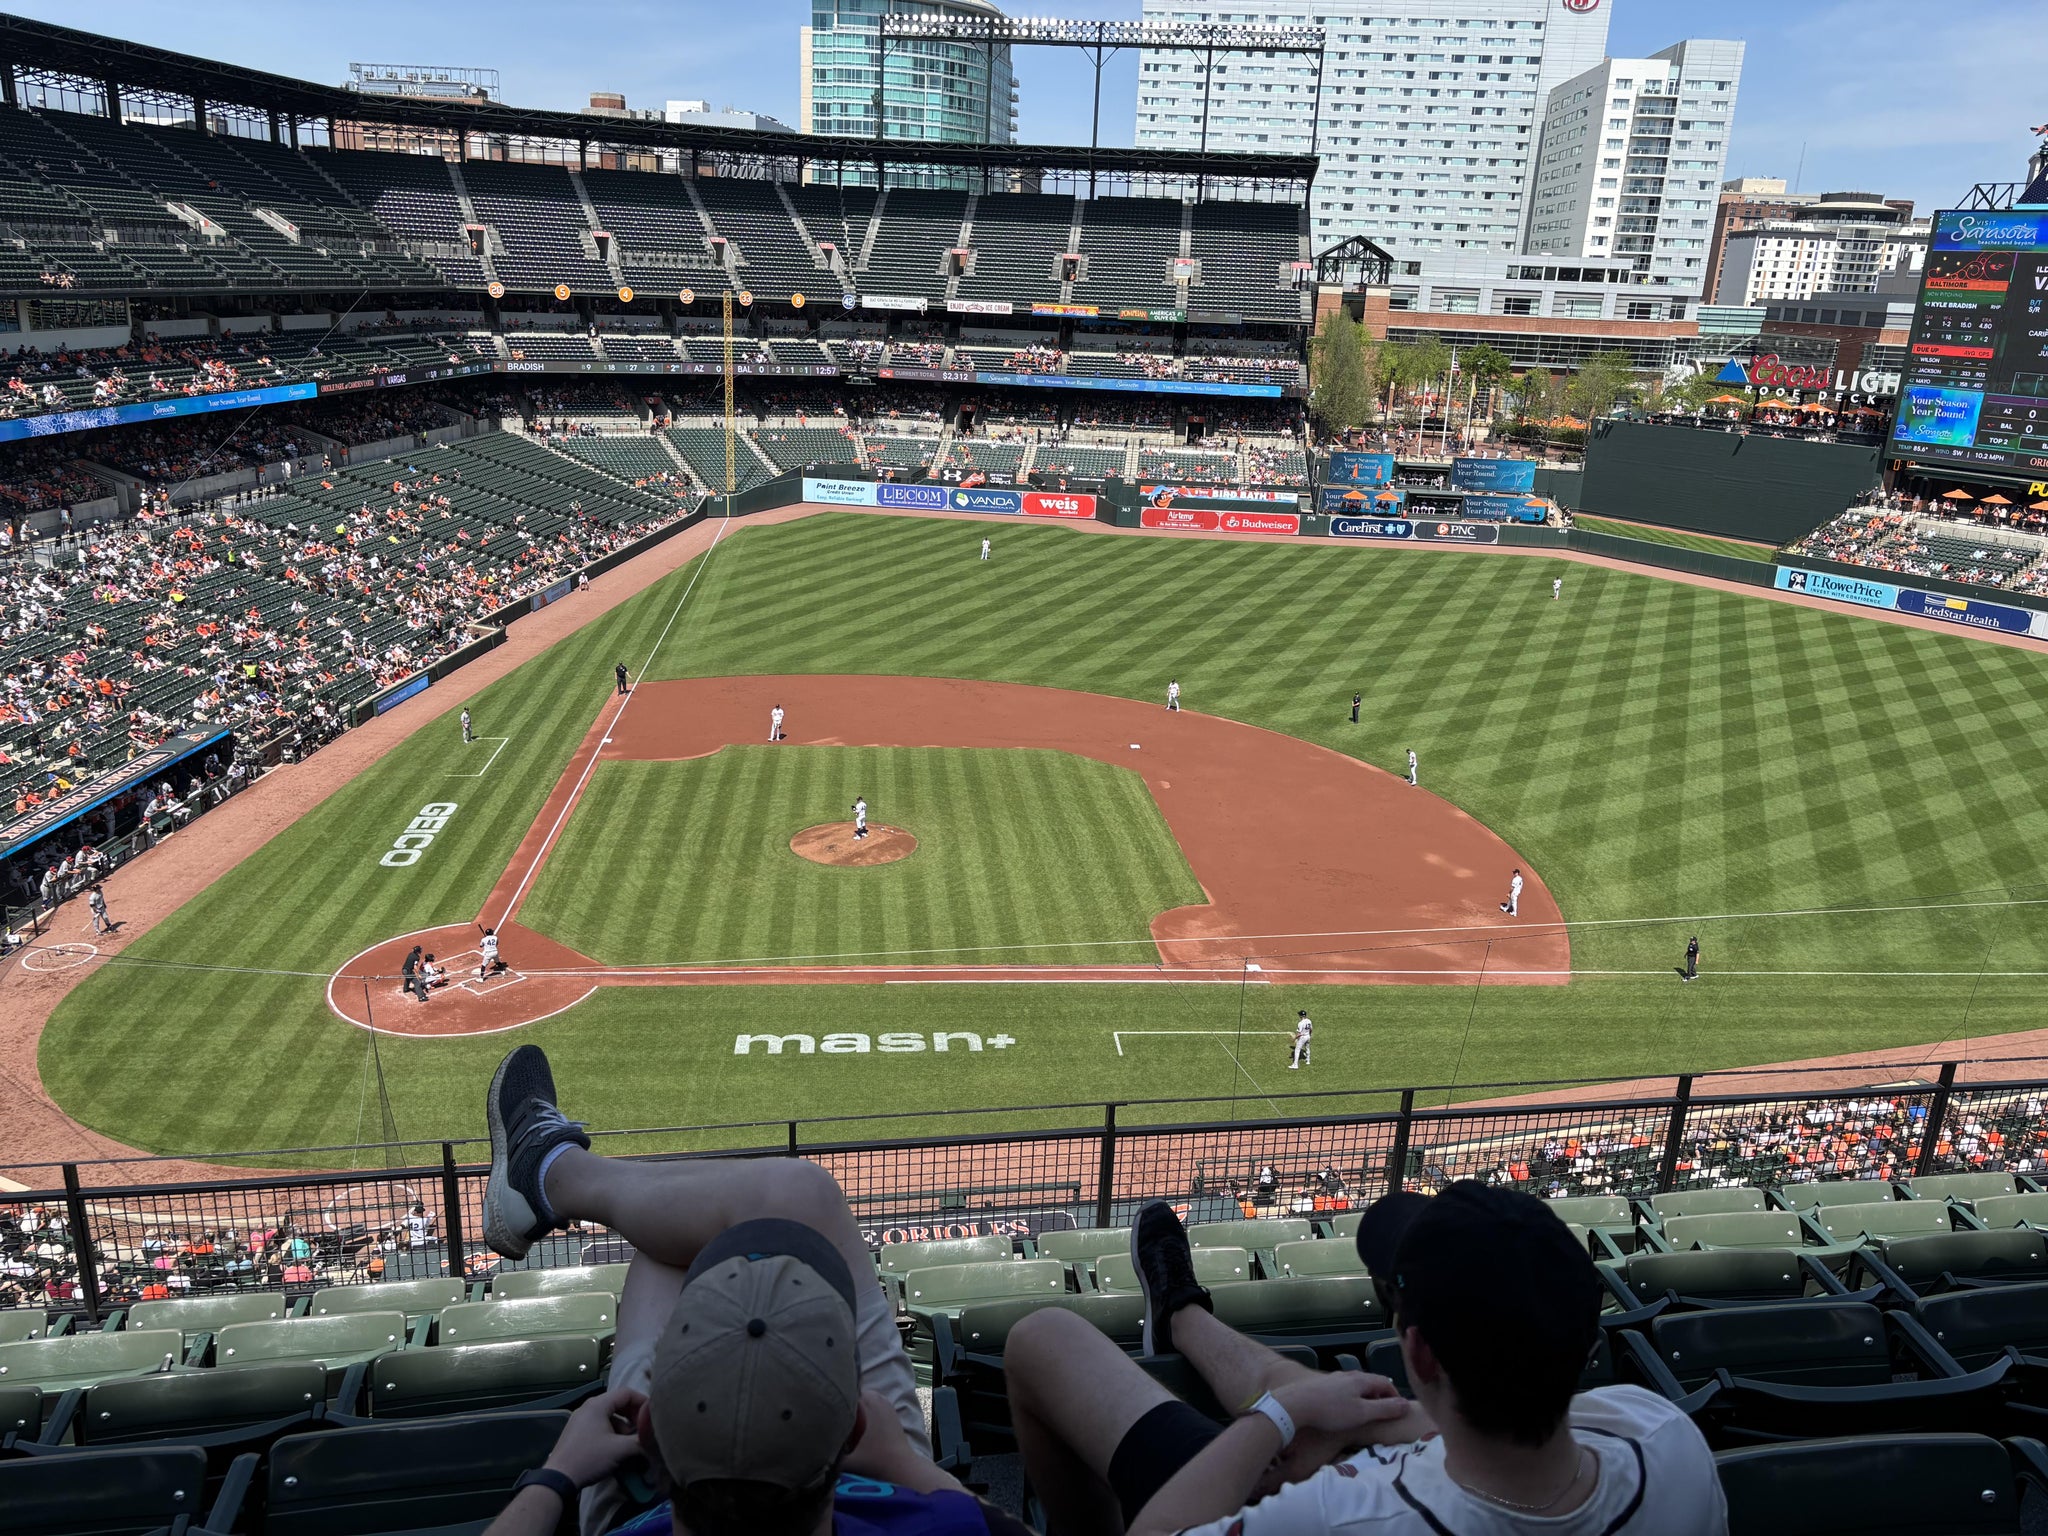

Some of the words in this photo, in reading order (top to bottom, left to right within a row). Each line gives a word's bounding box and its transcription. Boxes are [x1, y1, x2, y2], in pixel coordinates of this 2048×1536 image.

[402, 84, 423, 94] UMB
[1951, 216, 2039, 241] Sarasota
[491, 286, 502, 295] 20
[560, 288, 566, 298] 5
[623, 290, 629, 298] 4
[682, 292, 692, 300] 22
[741, 294, 751, 302] 33
[795, 296, 801, 305] 8
[844, 298, 854, 306] 42
[507, 363, 544, 371] BRADISH
[1750, 354, 1832, 389] Coors
[387, 374, 406, 384] VARGAS
[943, 372, 968, 381] $2,312
[1818, 391, 1877, 404] DECK
[1912, 396, 1933, 405] Your
[1934, 397, 1970, 408] Season.
[1912, 406, 1933, 416] Year
[1934, 408, 1967, 419] Round.
[2029, 410, 2037, 418] 0
[2026, 425, 2033, 433] 0
[1473, 462, 1498, 470] Season.
[838, 484, 866, 492] Breeze
[883, 489, 942, 502] LECOM
[1212, 489, 1237, 498] BIRD
[1240, 490, 1267, 499] BATH
[1325, 492, 1340, 500] Your
[970, 496, 1015, 507] VANDA
[1040, 497, 1079, 510] weis
[1483, 500, 1509, 508] Season.
[1168, 512, 1194, 520] Airtemp
[1338, 521, 1383, 534] CareFirst
[1451, 526, 1476, 536] PNC
[1846, 594, 1881, 604] CONFIDENCE
[1924, 606, 1964, 620] MedStar
[1965, 614, 2000, 627] Health
[379, 802, 458, 866] GEICO
[734, 1032, 1016, 1055] masn+
[882, 1218, 1030, 1245] ORIOLES
